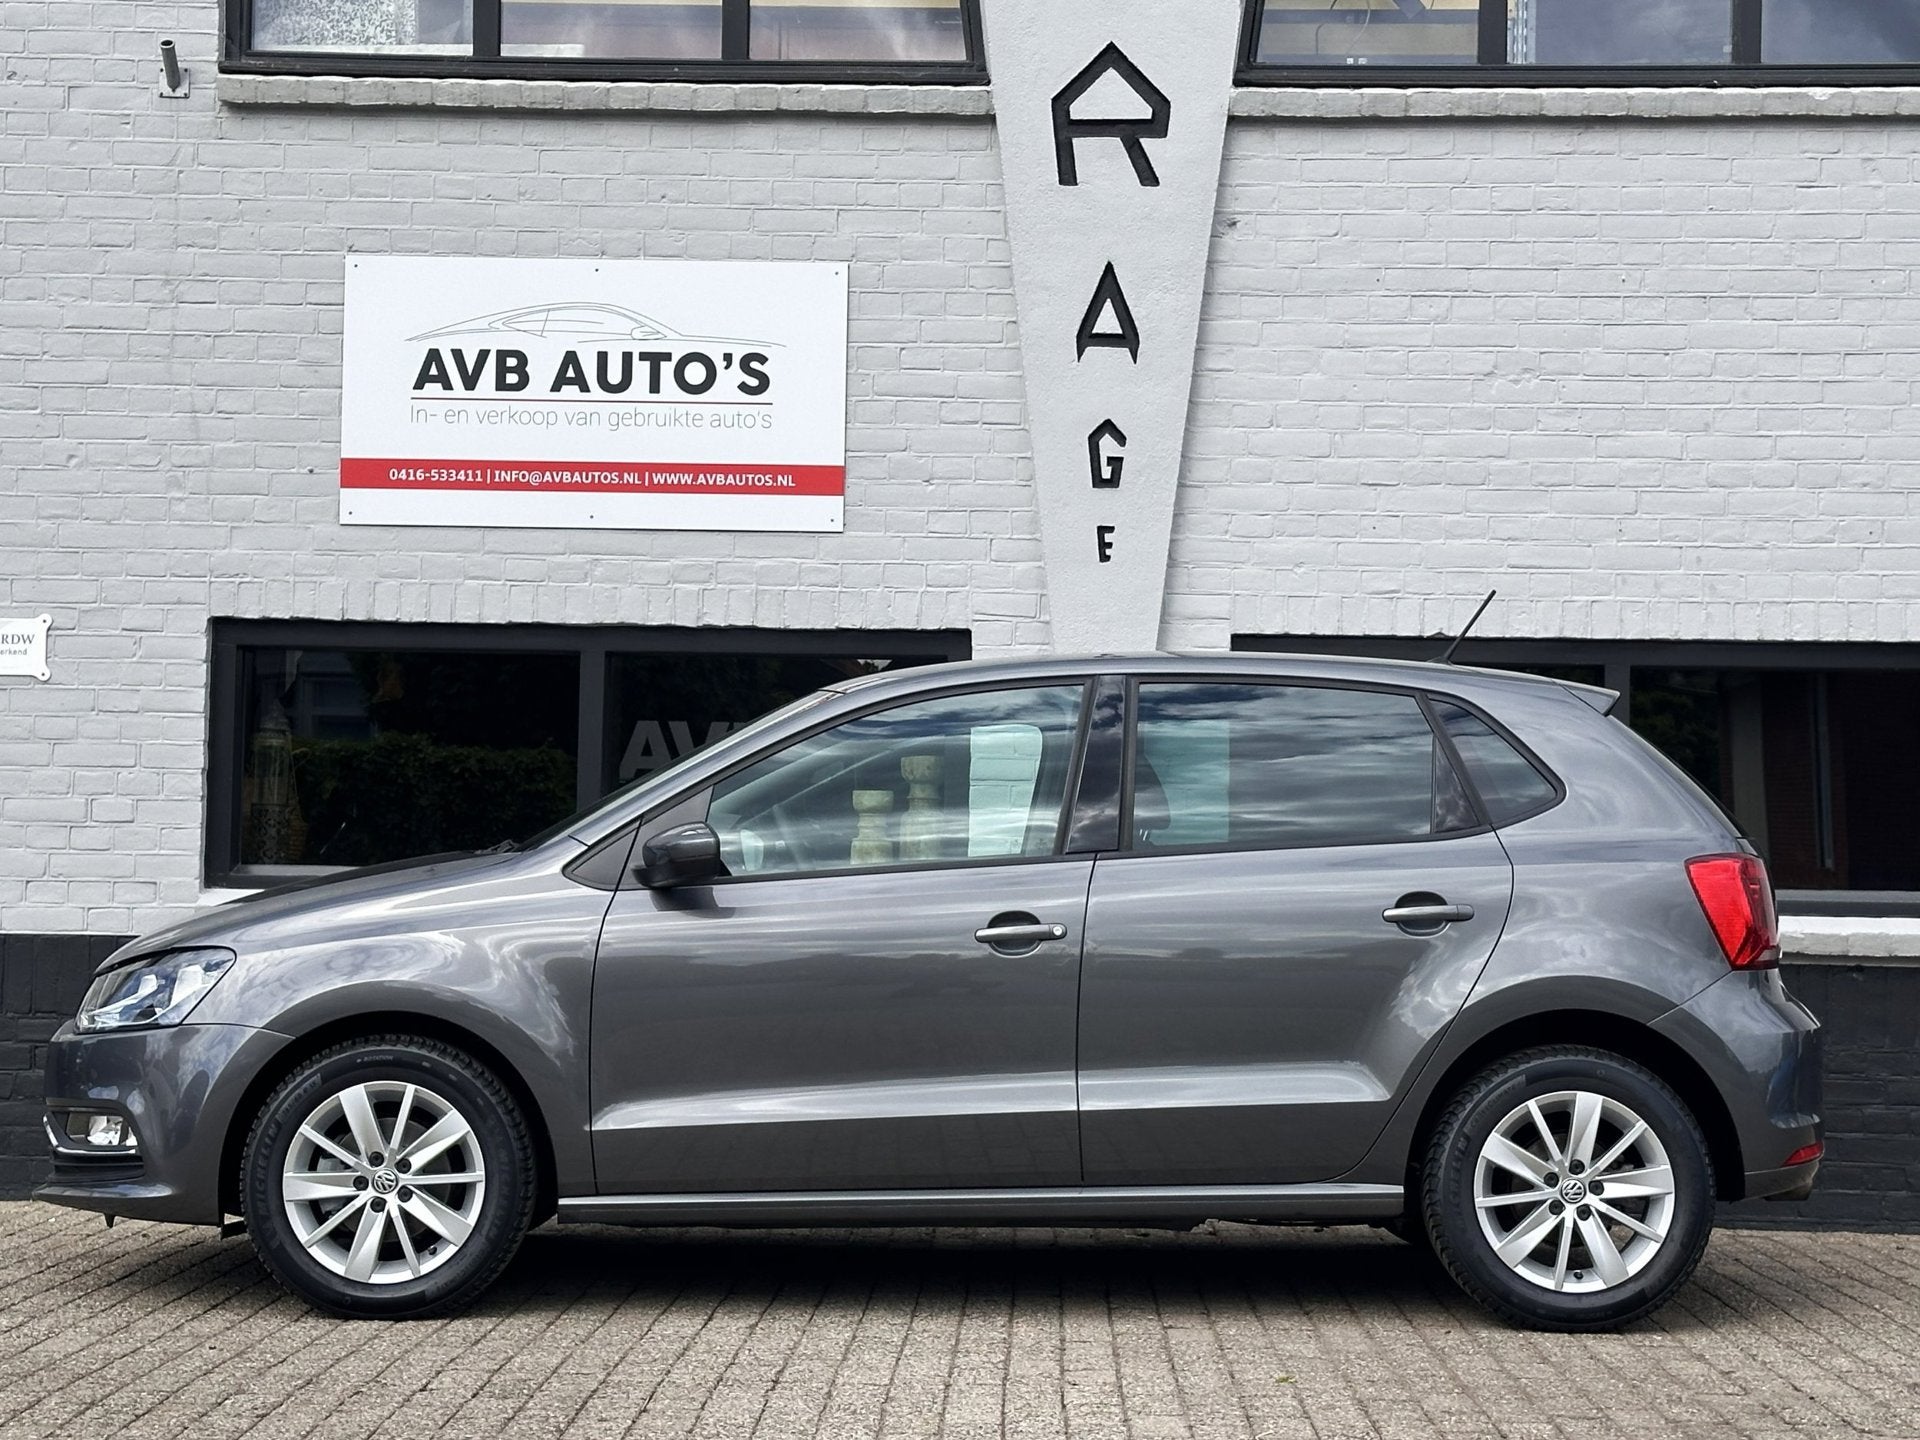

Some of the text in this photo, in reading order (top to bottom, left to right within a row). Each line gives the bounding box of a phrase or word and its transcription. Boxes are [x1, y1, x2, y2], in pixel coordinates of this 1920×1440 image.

[412, 347, 771, 396] AVB AUTO'S
[410, 405, 772, 431] In- en verkoop van gebruikte auto's
[389, 468, 796, 487] 0416-533411 INFO@AVBAUTOS.NL WWW.AVBAUTOS.NL
[1, 633, 35, 645] RDW
